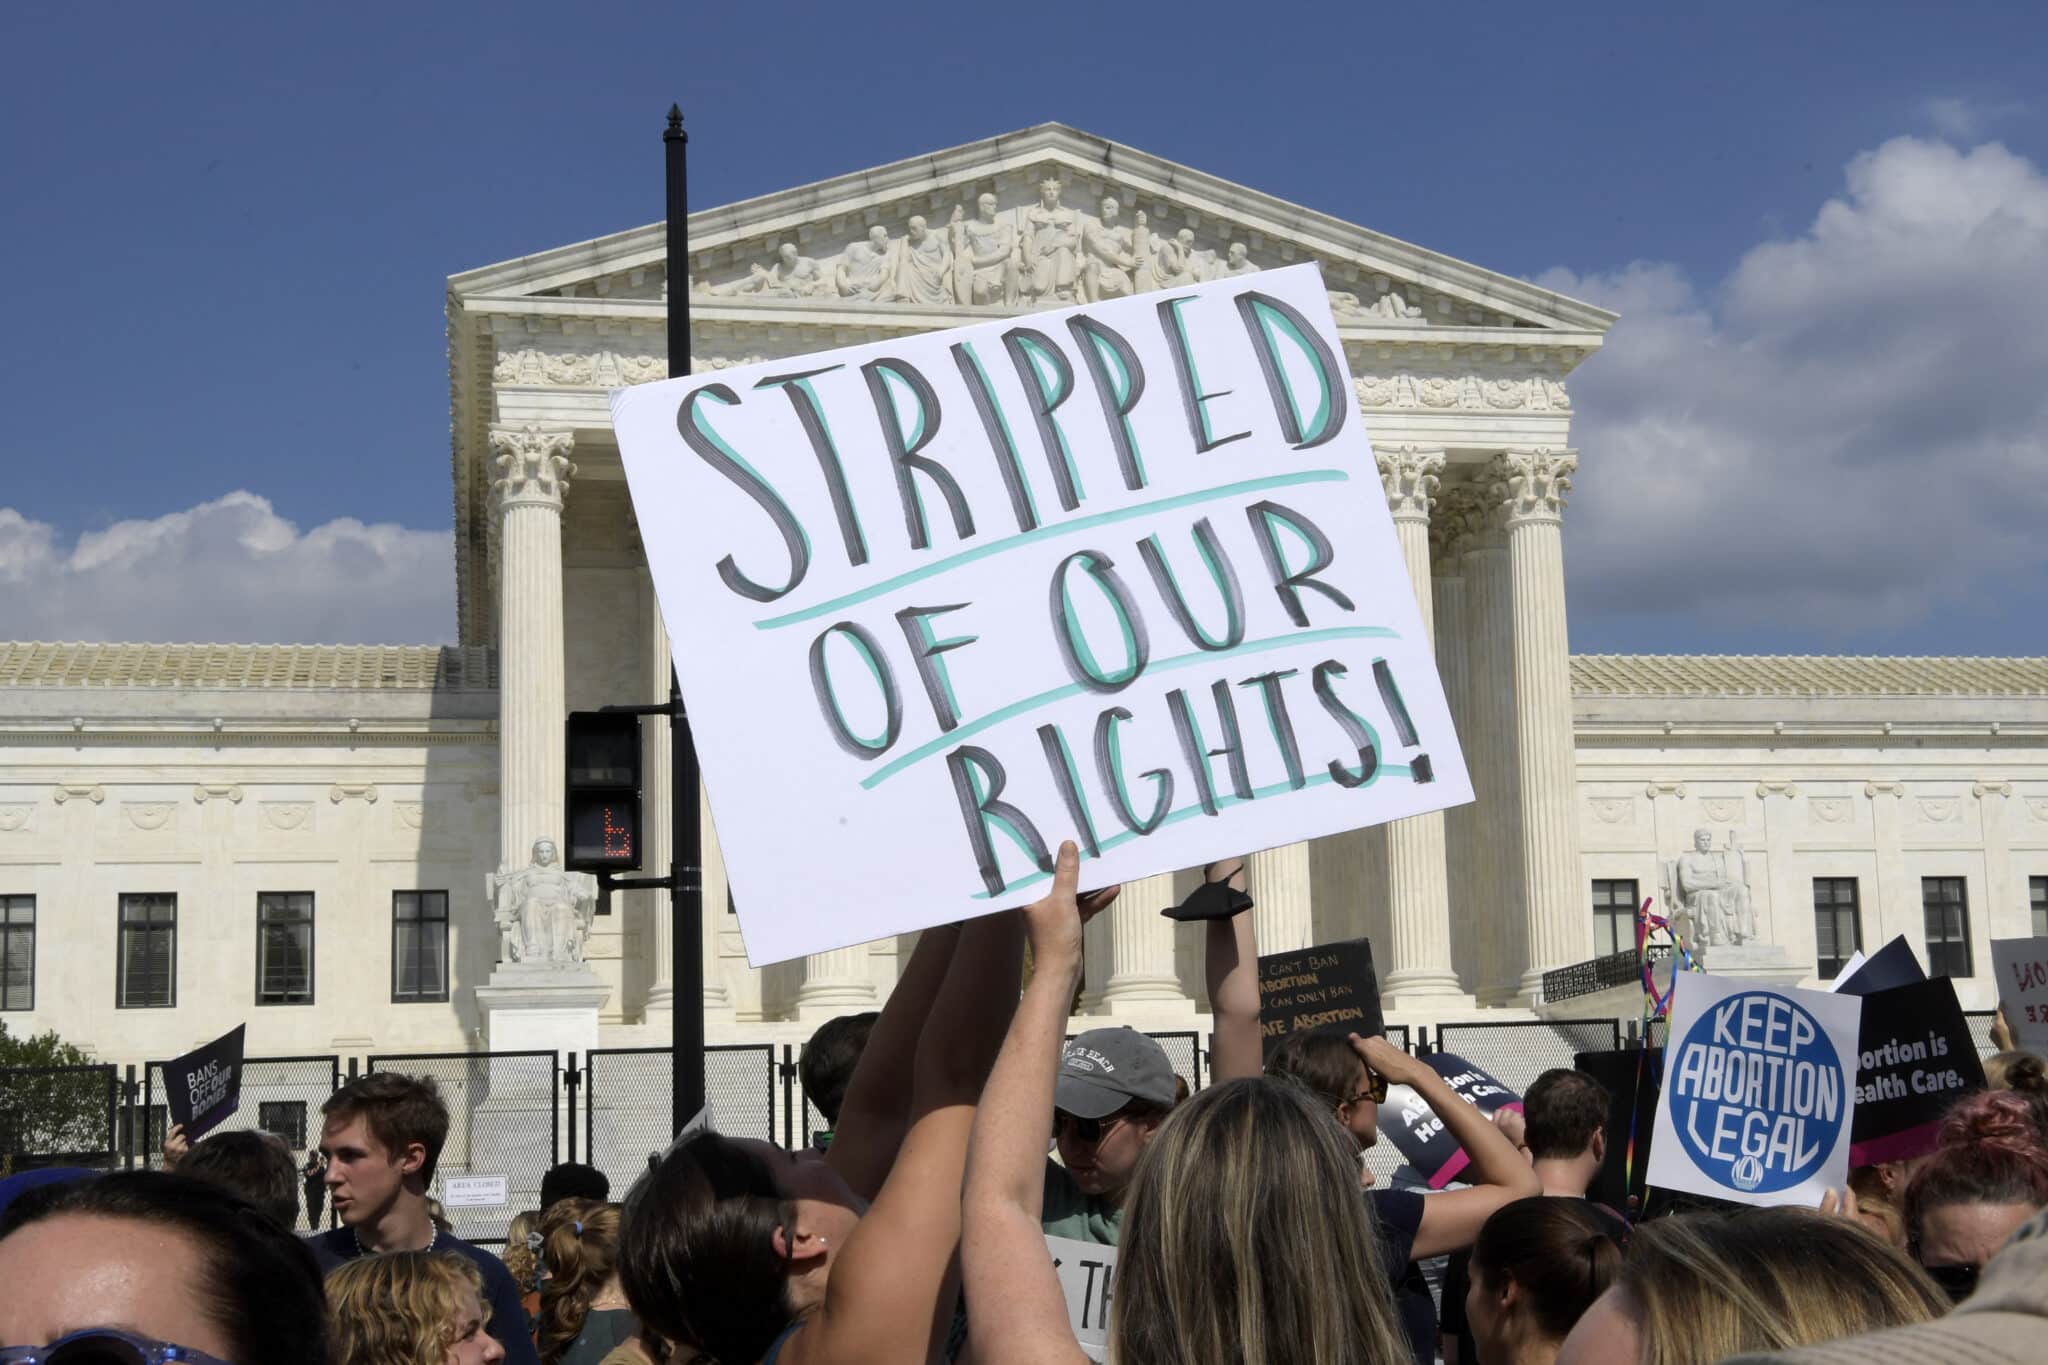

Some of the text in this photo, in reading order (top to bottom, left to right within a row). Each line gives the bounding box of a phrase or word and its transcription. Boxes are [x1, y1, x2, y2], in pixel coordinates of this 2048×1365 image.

[677, 290, 1348, 602] STRIPPED
[808, 500, 1355, 760] OF OUR
[945, 657, 1434, 898] RIGHTS!
[1259, 973, 1319, 994] ABORTION
[1269, 960, 1302, 976] CAN'T
[1308, 954, 1338, 970] BAN
[1271, 997, 1293, 1009] CAN
[1296, 989, 1327, 1004] ONLY
[1329, 983, 1353, 998] BAN
[1259, 1007, 1364, 1037] AFE ABORTION
[1713, 996, 1816, 1057] KEEP
[1857, 1030, 1949, 1071] ortion is
[186, 1060, 219, 1089] BANS
[190, 1065, 232, 1105] OFF OUR
[1676, 1042, 1839, 1123] ABORTION
[1855, 1069, 1964, 1105] ealth Care.
[191, 1083, 228, 1121] BODIES
[1686, 1100, 1820, 1173] LEGAL
